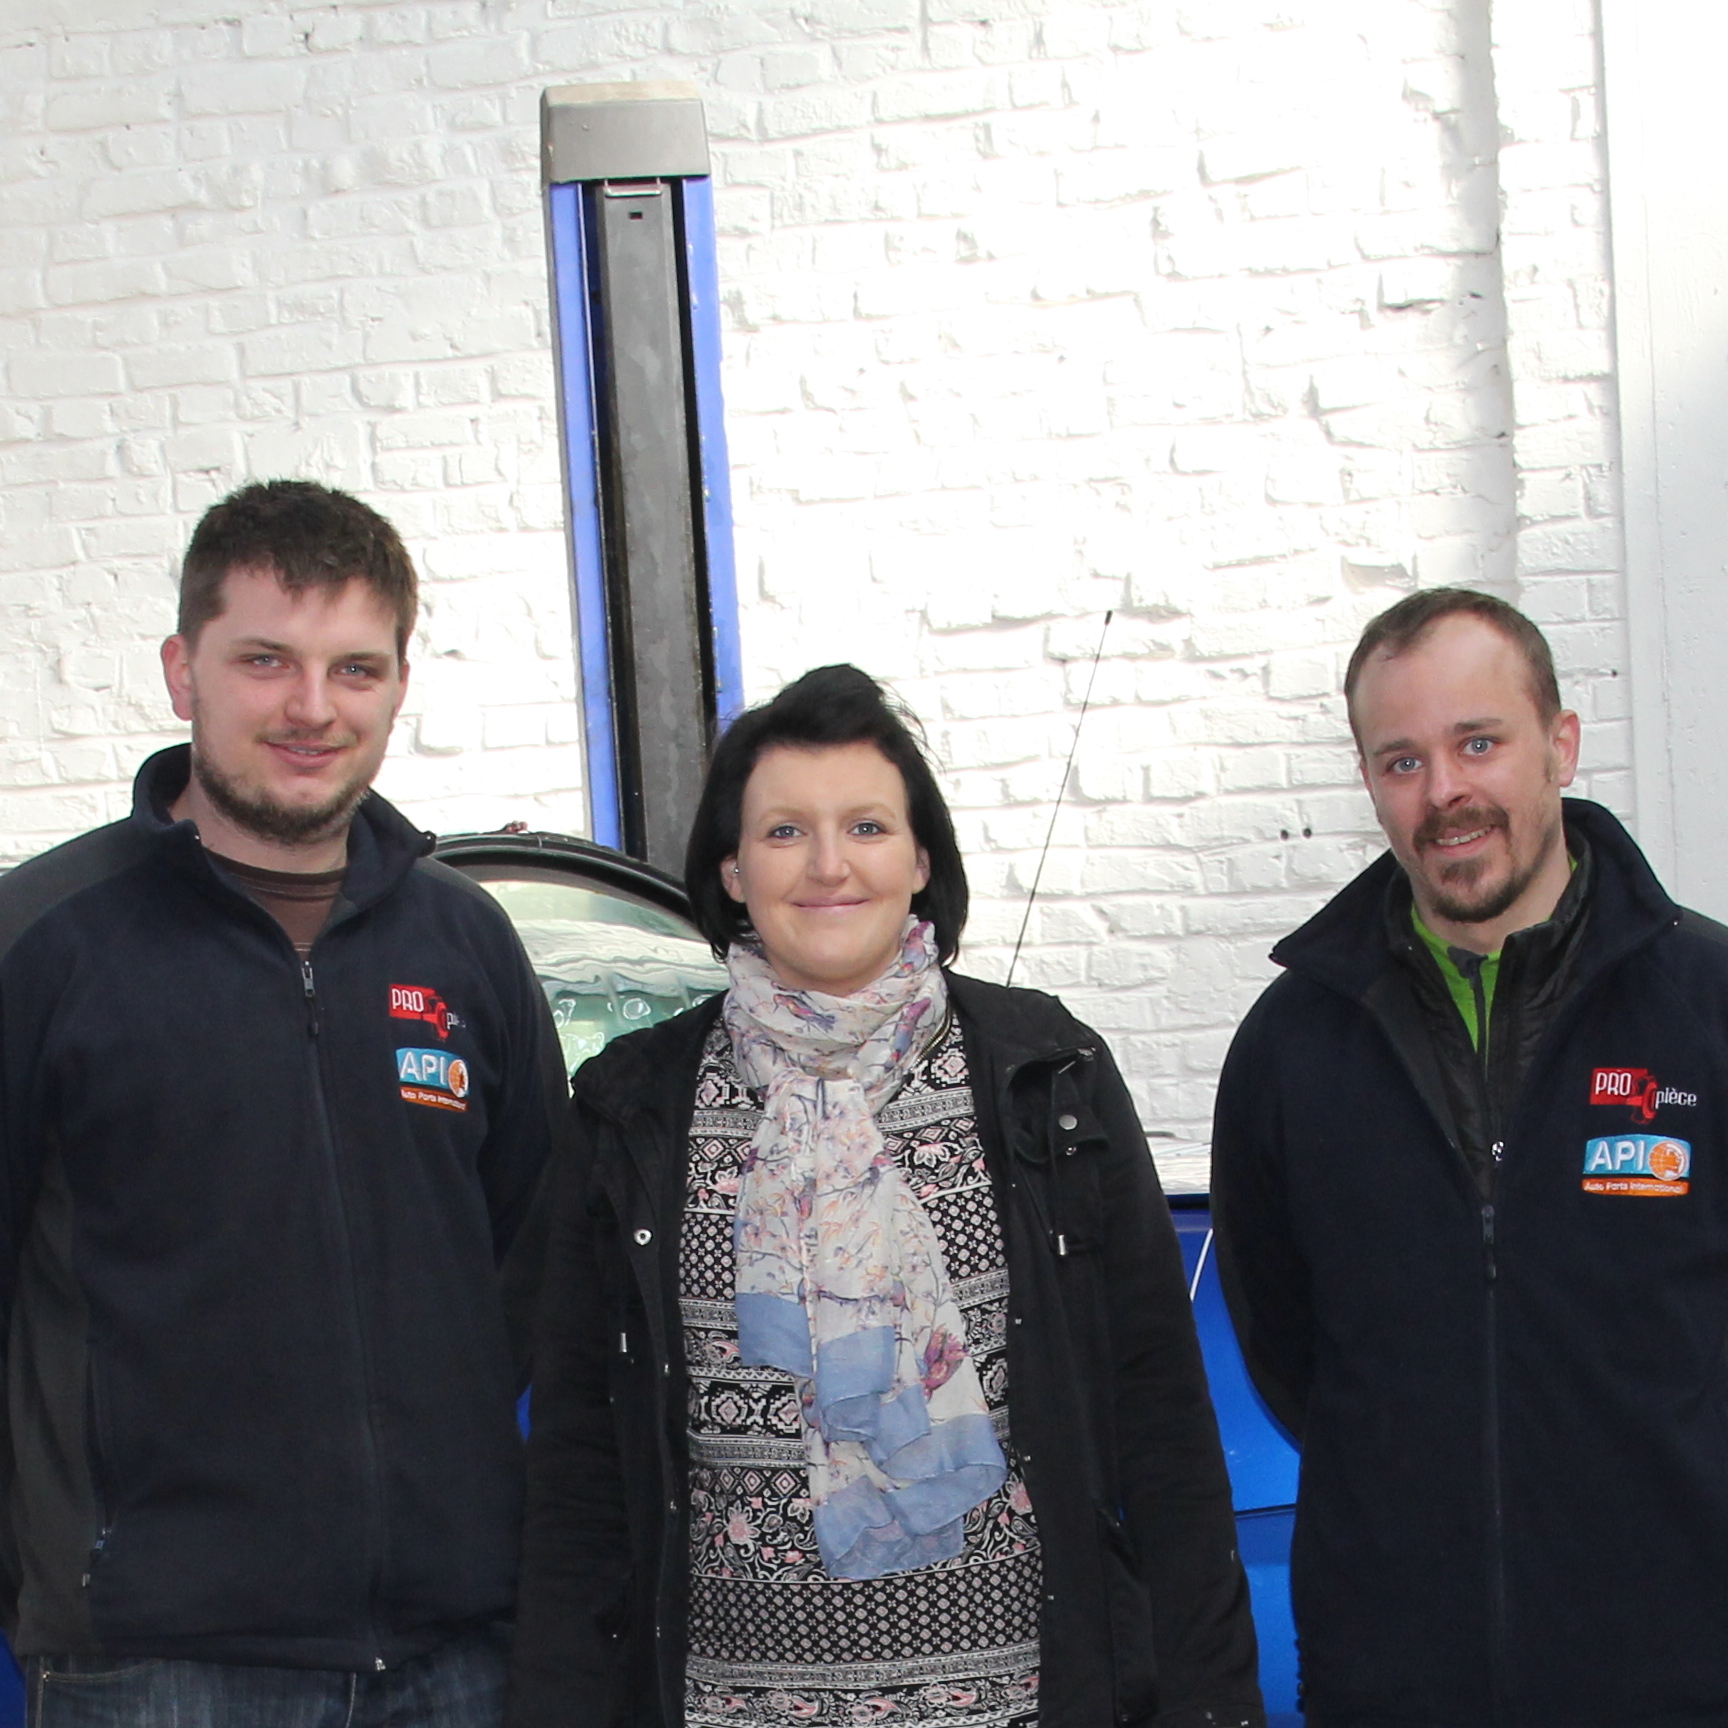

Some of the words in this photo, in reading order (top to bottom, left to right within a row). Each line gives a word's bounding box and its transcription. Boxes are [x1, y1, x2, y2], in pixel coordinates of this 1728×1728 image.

[391, 988, 425, 1012] PRO
[400, 1051, 447, 1085] API
[1595, 1072, 1632, 1096] PRO
[1655, 1087, 1697, 1110] pièce
[1590, 1140, 1645, 1171] API
[1584, 1181, 1604, 1191] Auto
[1606, 1181, 1628, 1191] Parts
